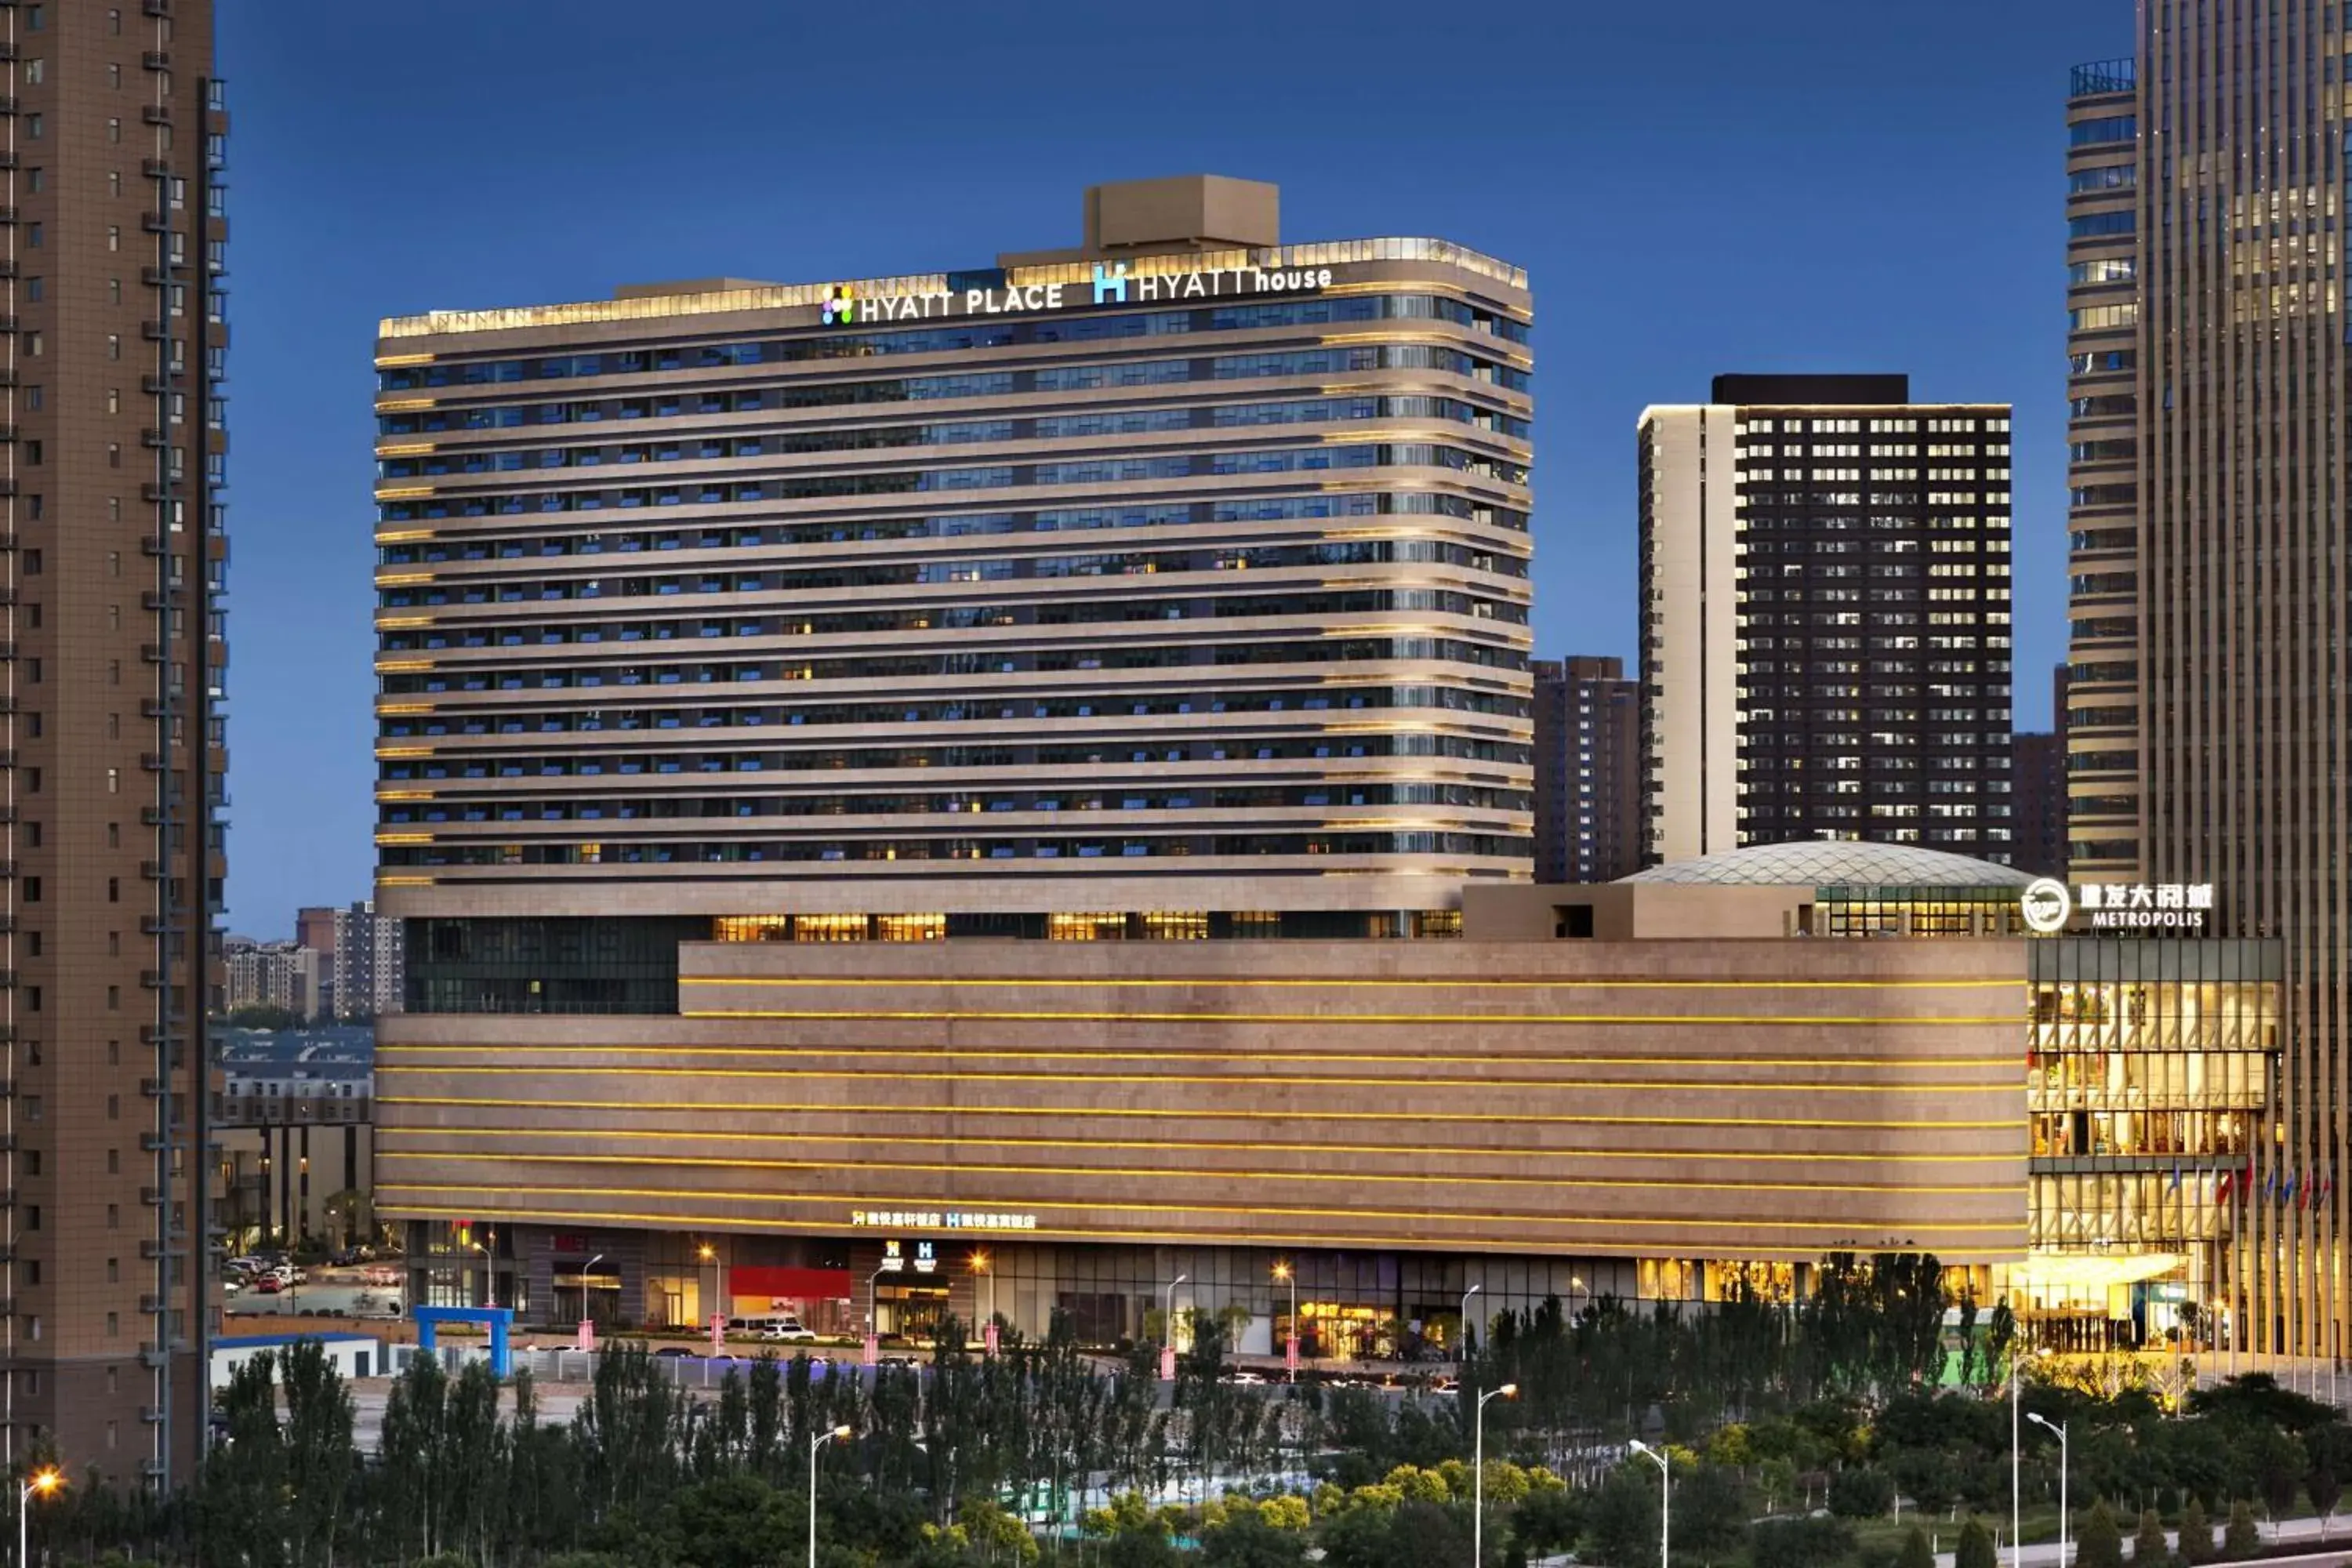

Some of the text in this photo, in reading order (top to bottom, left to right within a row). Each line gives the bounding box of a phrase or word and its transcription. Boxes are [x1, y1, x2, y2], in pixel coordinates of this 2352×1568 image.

[1138, 267, 1254, 301] HYATT
[1255, 267, 1332, 292] house
[862, 283, 1063, 322] HYATT PLACE
[2092, 912, 2203, 927] METROPOLIS
